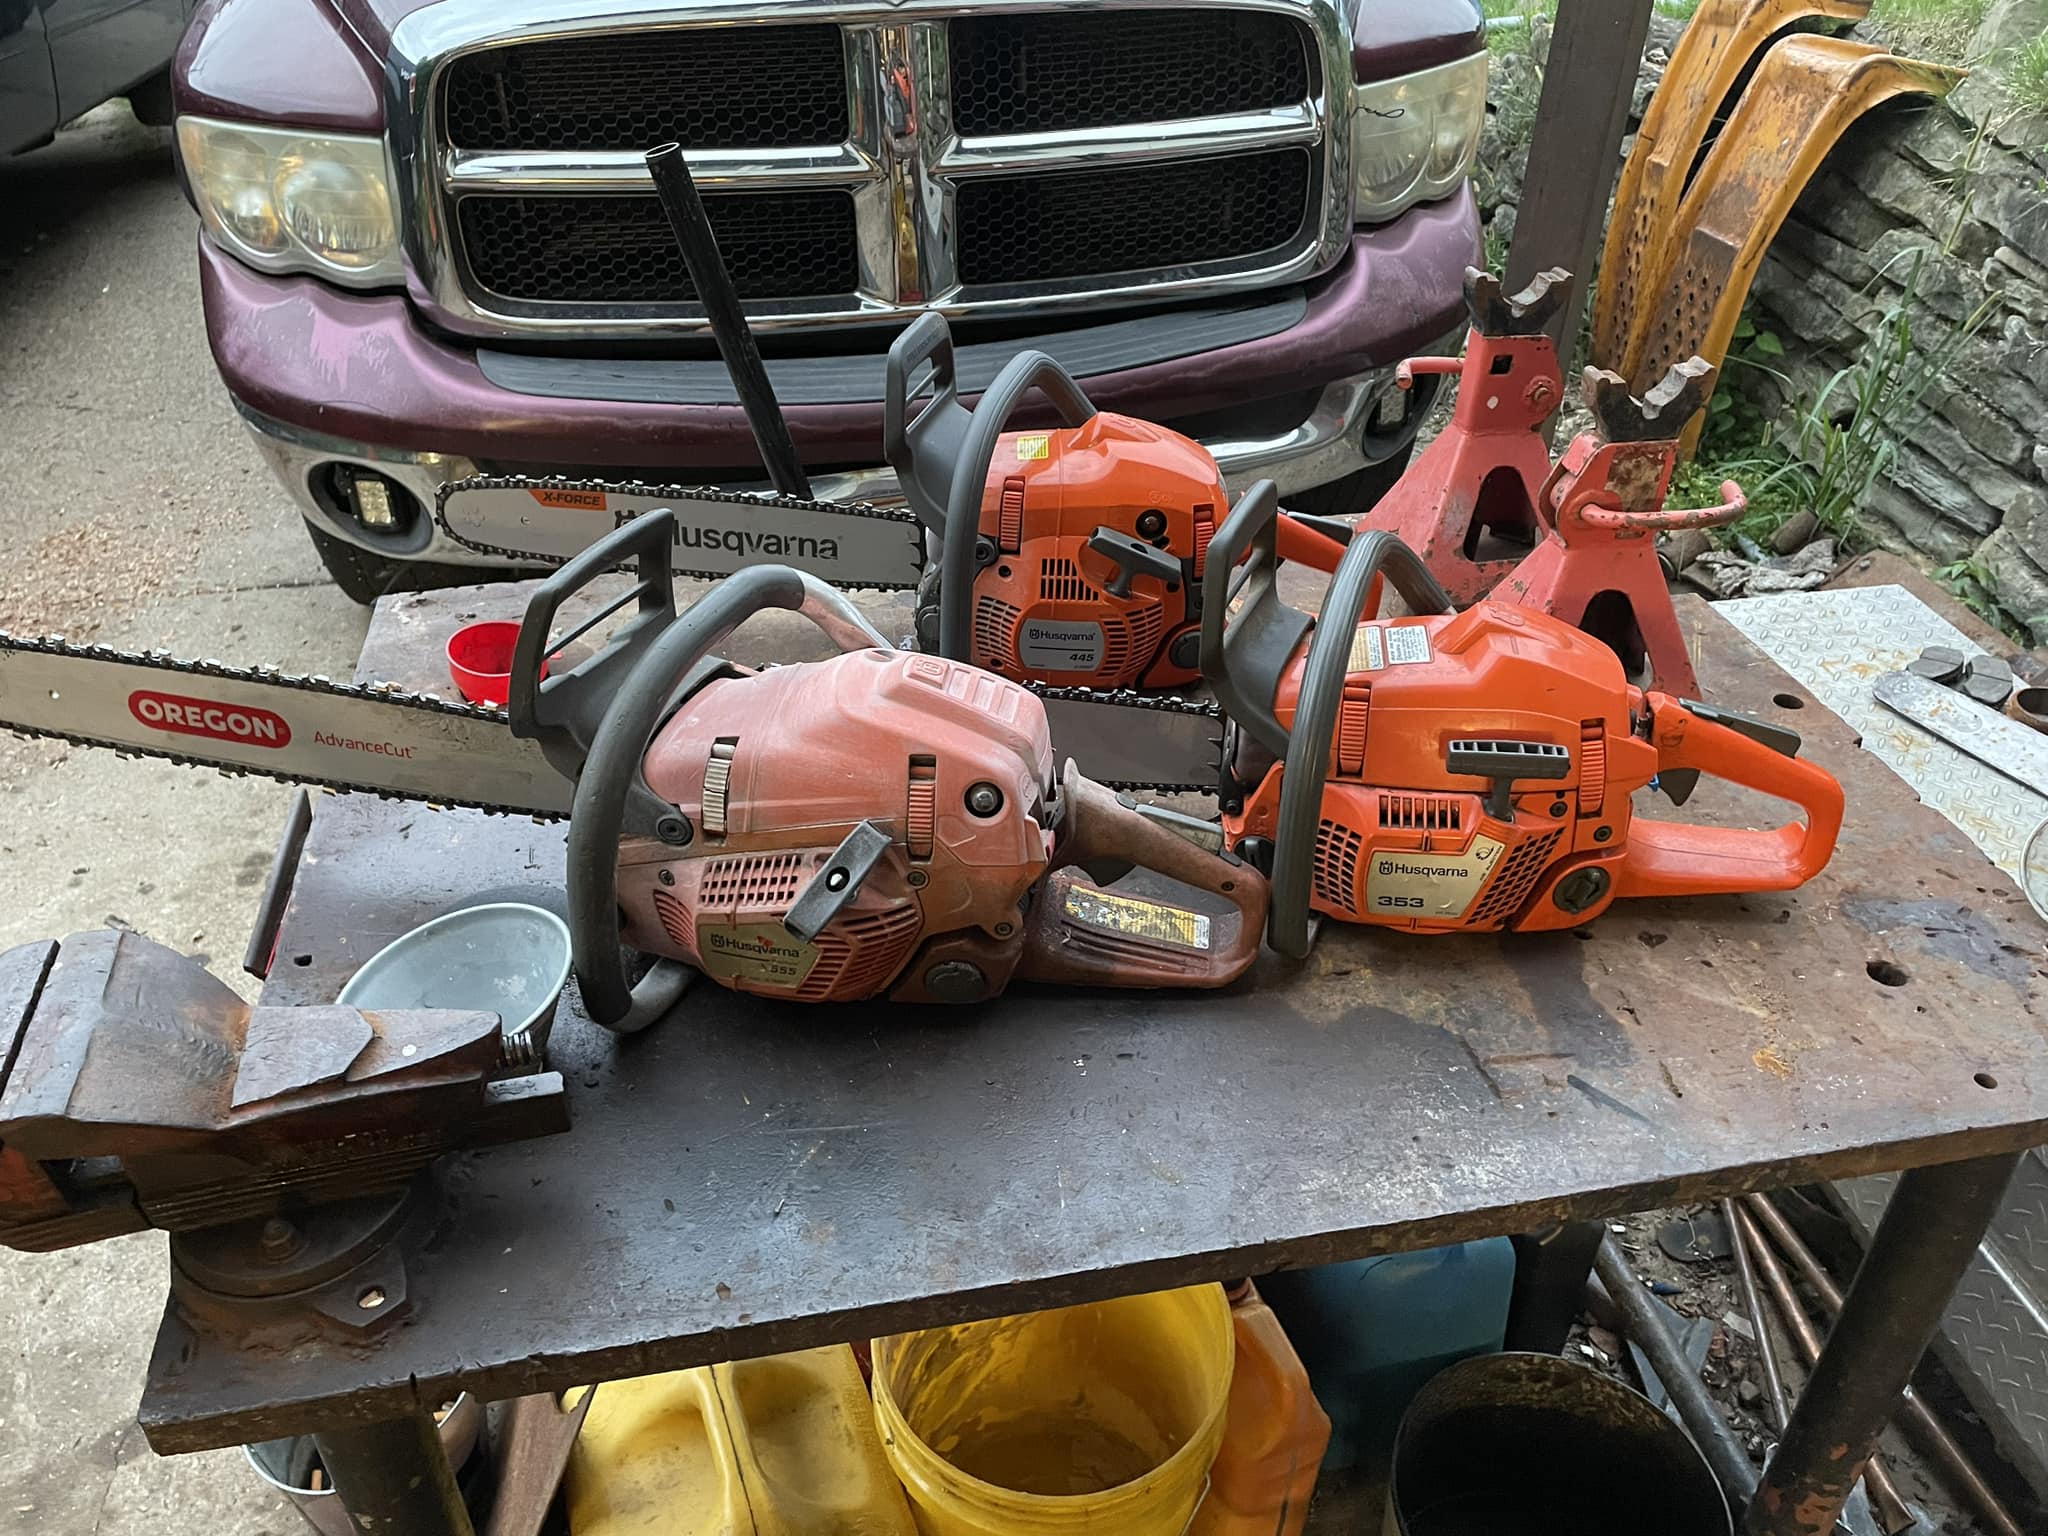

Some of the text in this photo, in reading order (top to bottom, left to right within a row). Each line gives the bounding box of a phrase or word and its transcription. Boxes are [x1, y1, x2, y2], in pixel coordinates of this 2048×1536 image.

[543, 491, 601, 506] X-FORCE
[1041, 630, 1094, 641] Husqvarna
[1069, 653, 1094, 662] 445
[138, 698, 277, 740] OREGON
[314, 731, 413, 759] AdvanceCut
[1394, 863, 1469, 878] Husqvarna
[1377, 896, 1425, 908] 353
[725, 937, 800, 958] Husqvarna
[769, 964, 797, 976] 555
